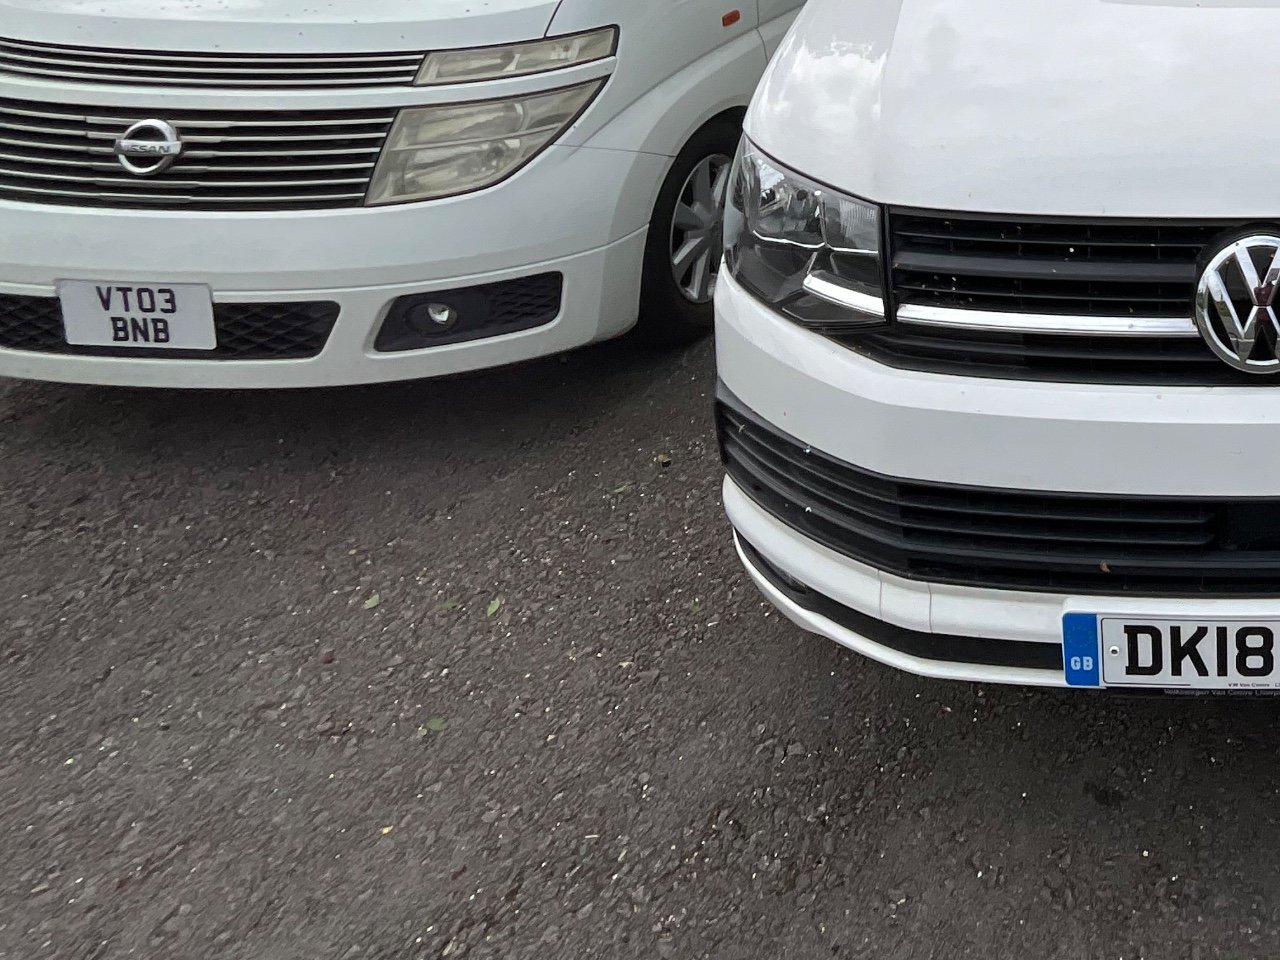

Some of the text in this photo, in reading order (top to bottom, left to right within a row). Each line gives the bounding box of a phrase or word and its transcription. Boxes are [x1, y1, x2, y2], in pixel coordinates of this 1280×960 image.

[96, 286, 177, 314] VT03
[111, 316, 170, 343] BNB
[1070, 656, 1094, 671] GB
[1124, 623, 1275, 677] DK18
